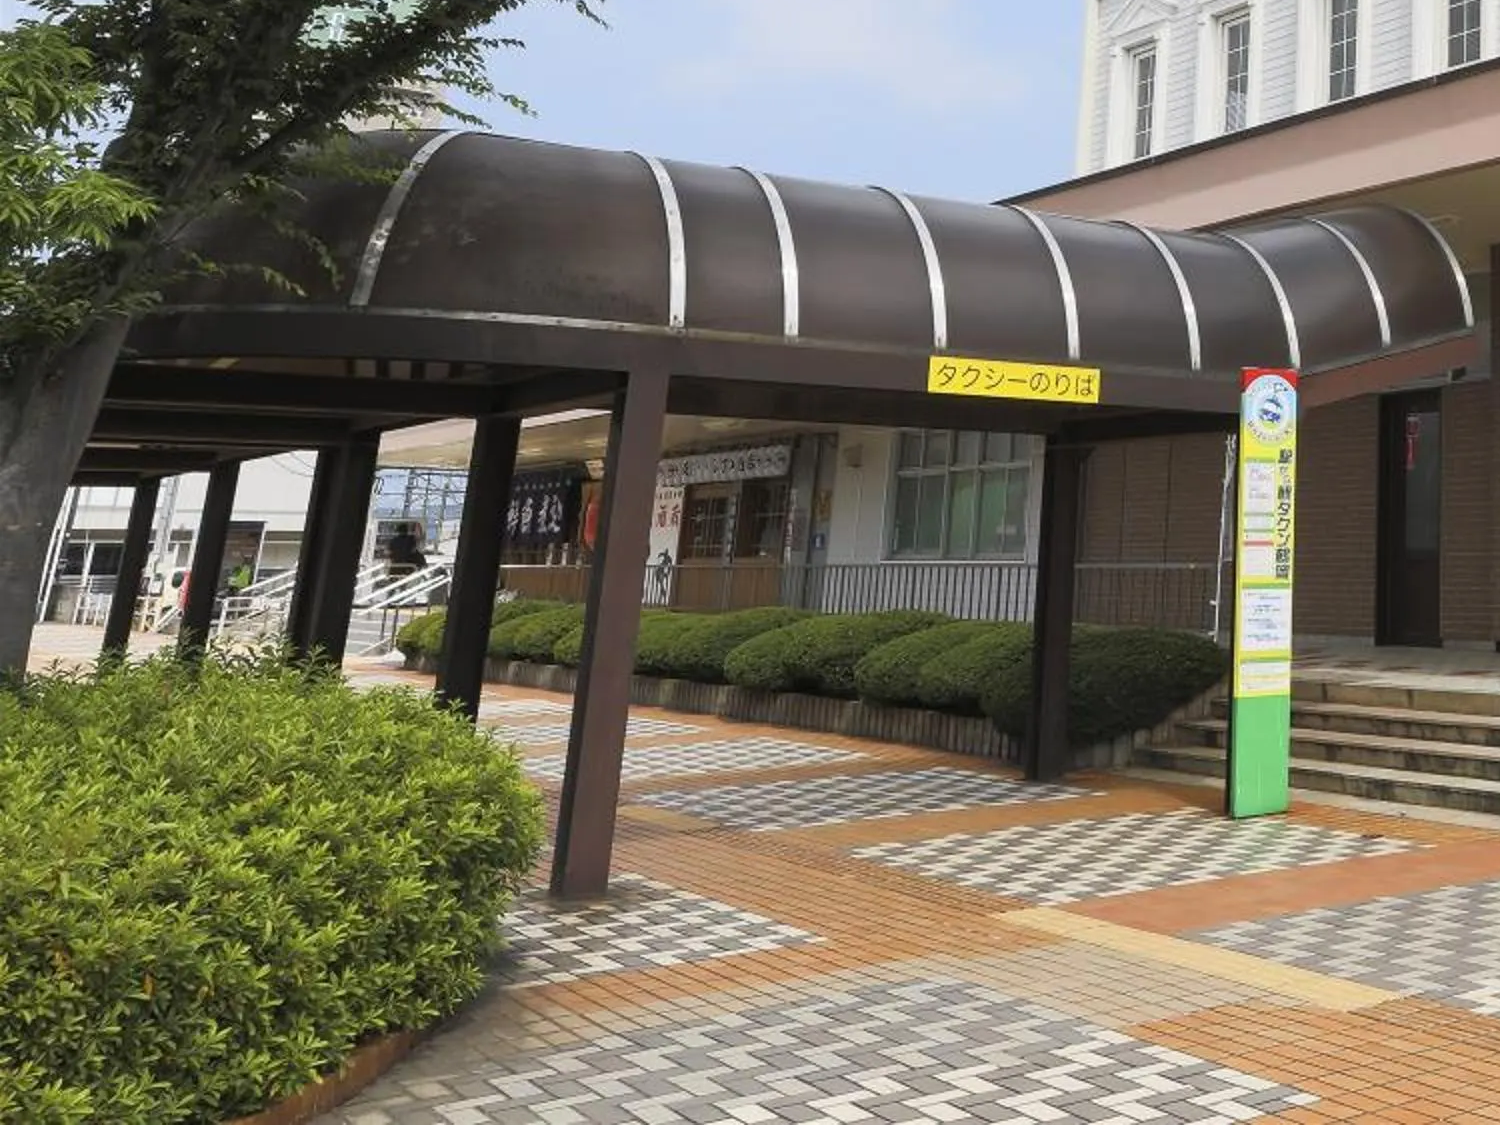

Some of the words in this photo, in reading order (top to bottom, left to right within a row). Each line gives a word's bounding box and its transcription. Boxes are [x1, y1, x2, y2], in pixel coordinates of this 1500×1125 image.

[937, 363, 1095, 396] タクシーのりば
